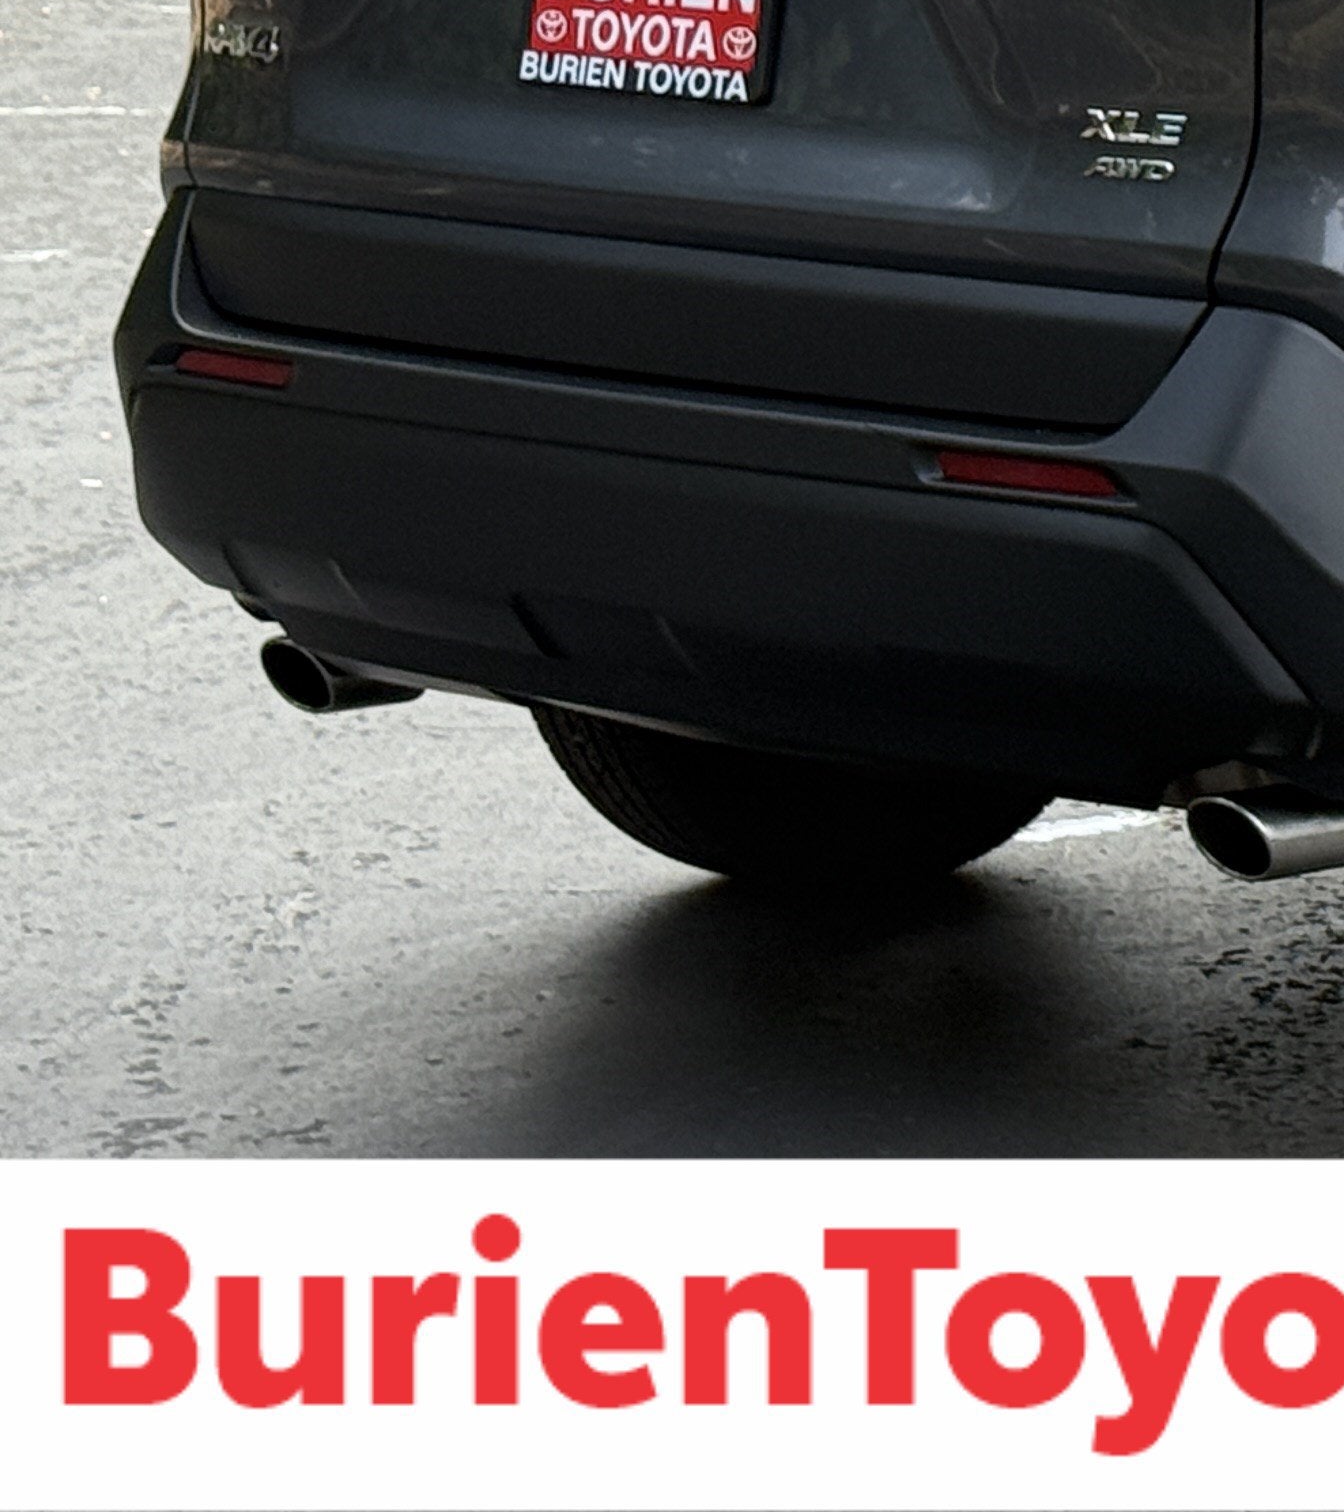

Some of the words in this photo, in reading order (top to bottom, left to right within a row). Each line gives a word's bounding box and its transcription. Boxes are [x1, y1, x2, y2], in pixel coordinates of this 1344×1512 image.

[571, 7, 717, 62] TOYOTA
[518, 49, 627, 89] BURIEN
[633, 60, 750, 103] TOYOTA
[1079, 107, 1189, 146] XLE
[1083, 155, 1176, 181] AWD
